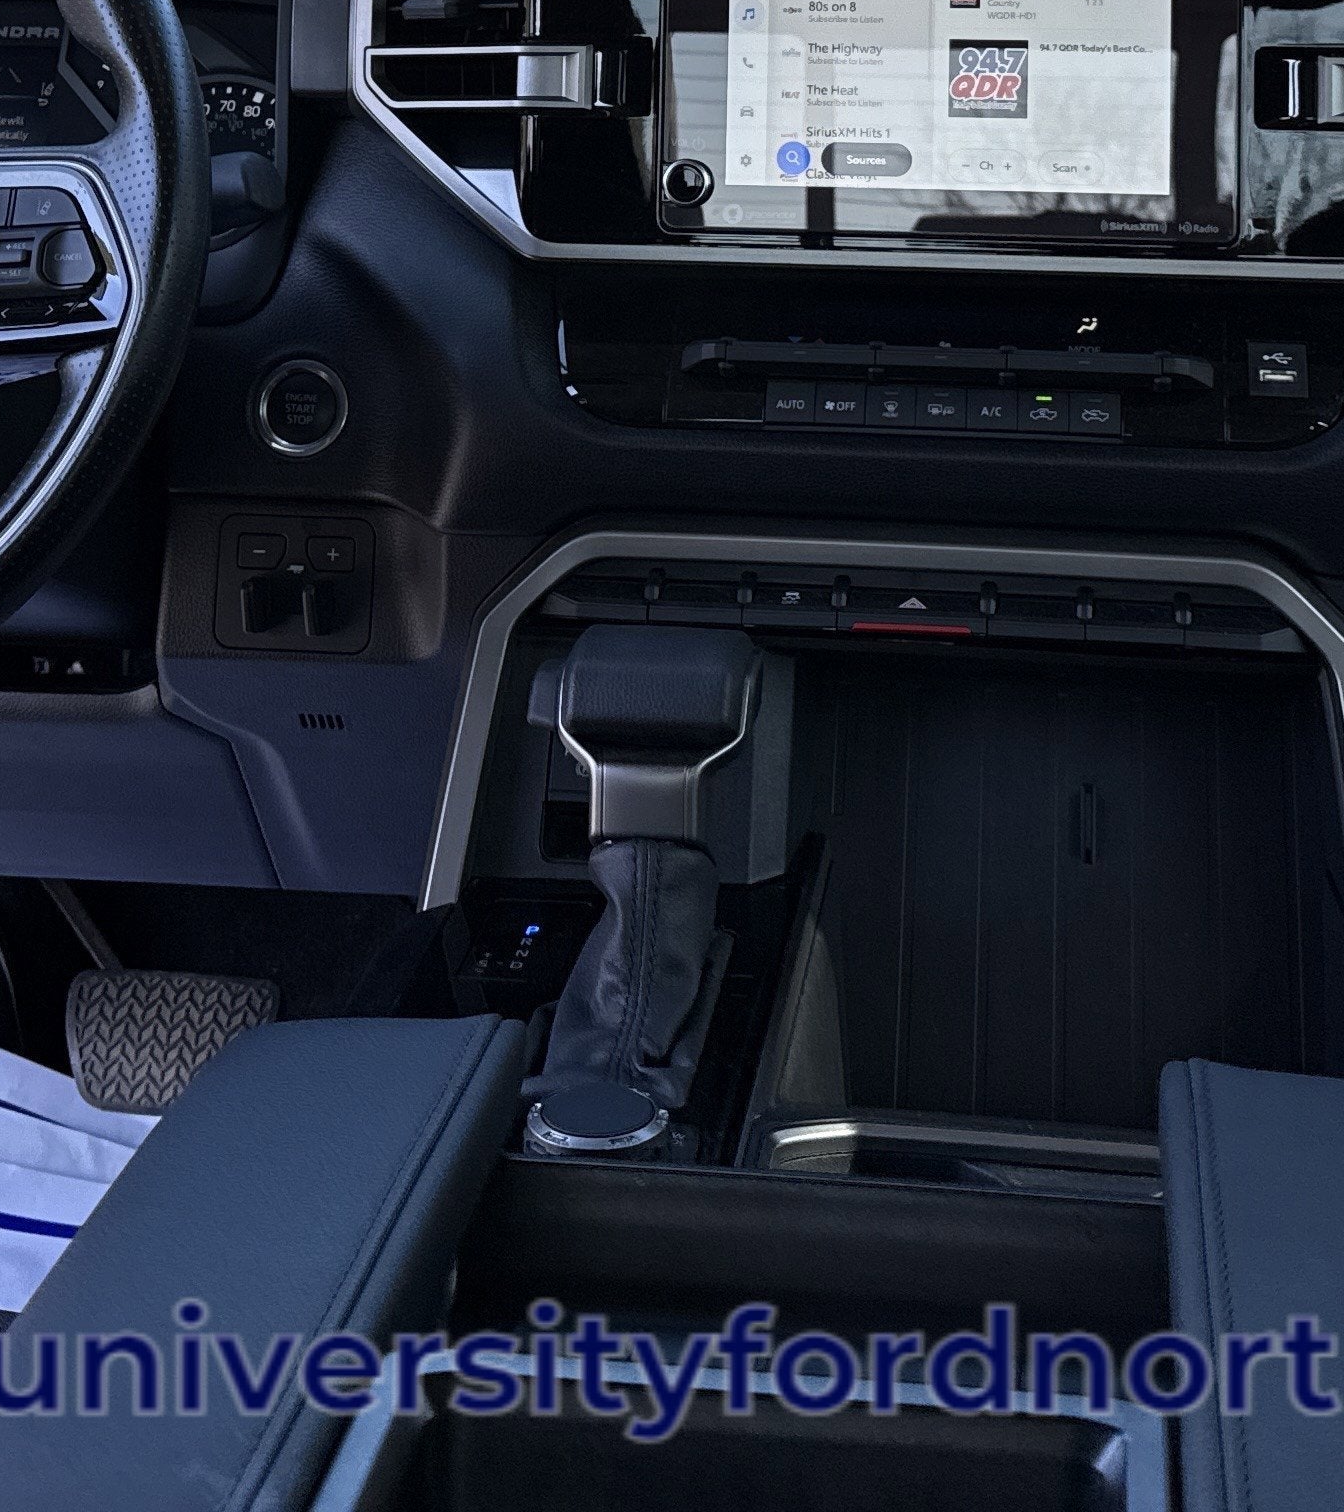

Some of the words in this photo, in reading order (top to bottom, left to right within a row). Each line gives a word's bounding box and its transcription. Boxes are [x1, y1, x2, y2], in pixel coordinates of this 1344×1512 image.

[808, 1, 829, 12] 80s
[832, 3, 847, 12] on
[849, 1, 857, 12] 8
[987, 0, 1019, 8] Country
[808, 15, 848, 24] Subscribe
[859, 16, 884, 24] Listen
[808, 42, 829, 54] The
[832, 43, 883, 57] Highway
[958, 46, 1028, 74] 94.7
[807, 84, 829, 96] The
[831, 85, 859, 96] Heat
[949, 72, 1022, 101] QDR
[219, 99, 236, 112] 70
[243, 105, 261, 117] 80
[806, 126, 856, 138] SiriusXM
[859, 127, 881, 138] Hits
[846, 155, 887, 166] Sources
[979, 161, 994, 171] Ch
[1052, 162, 1077, 173] Scan
[1193, 224, 1219, 233] Radio
[53, 252, 83, 262] CANCEL
[285, 403, 317, 413] START
[776, 399, 805, 409] AUTO
[836, 401, 857, 412] OFF
[981, 406, 1002, 417] A/C
[286, 414, 313, 425] STOP
